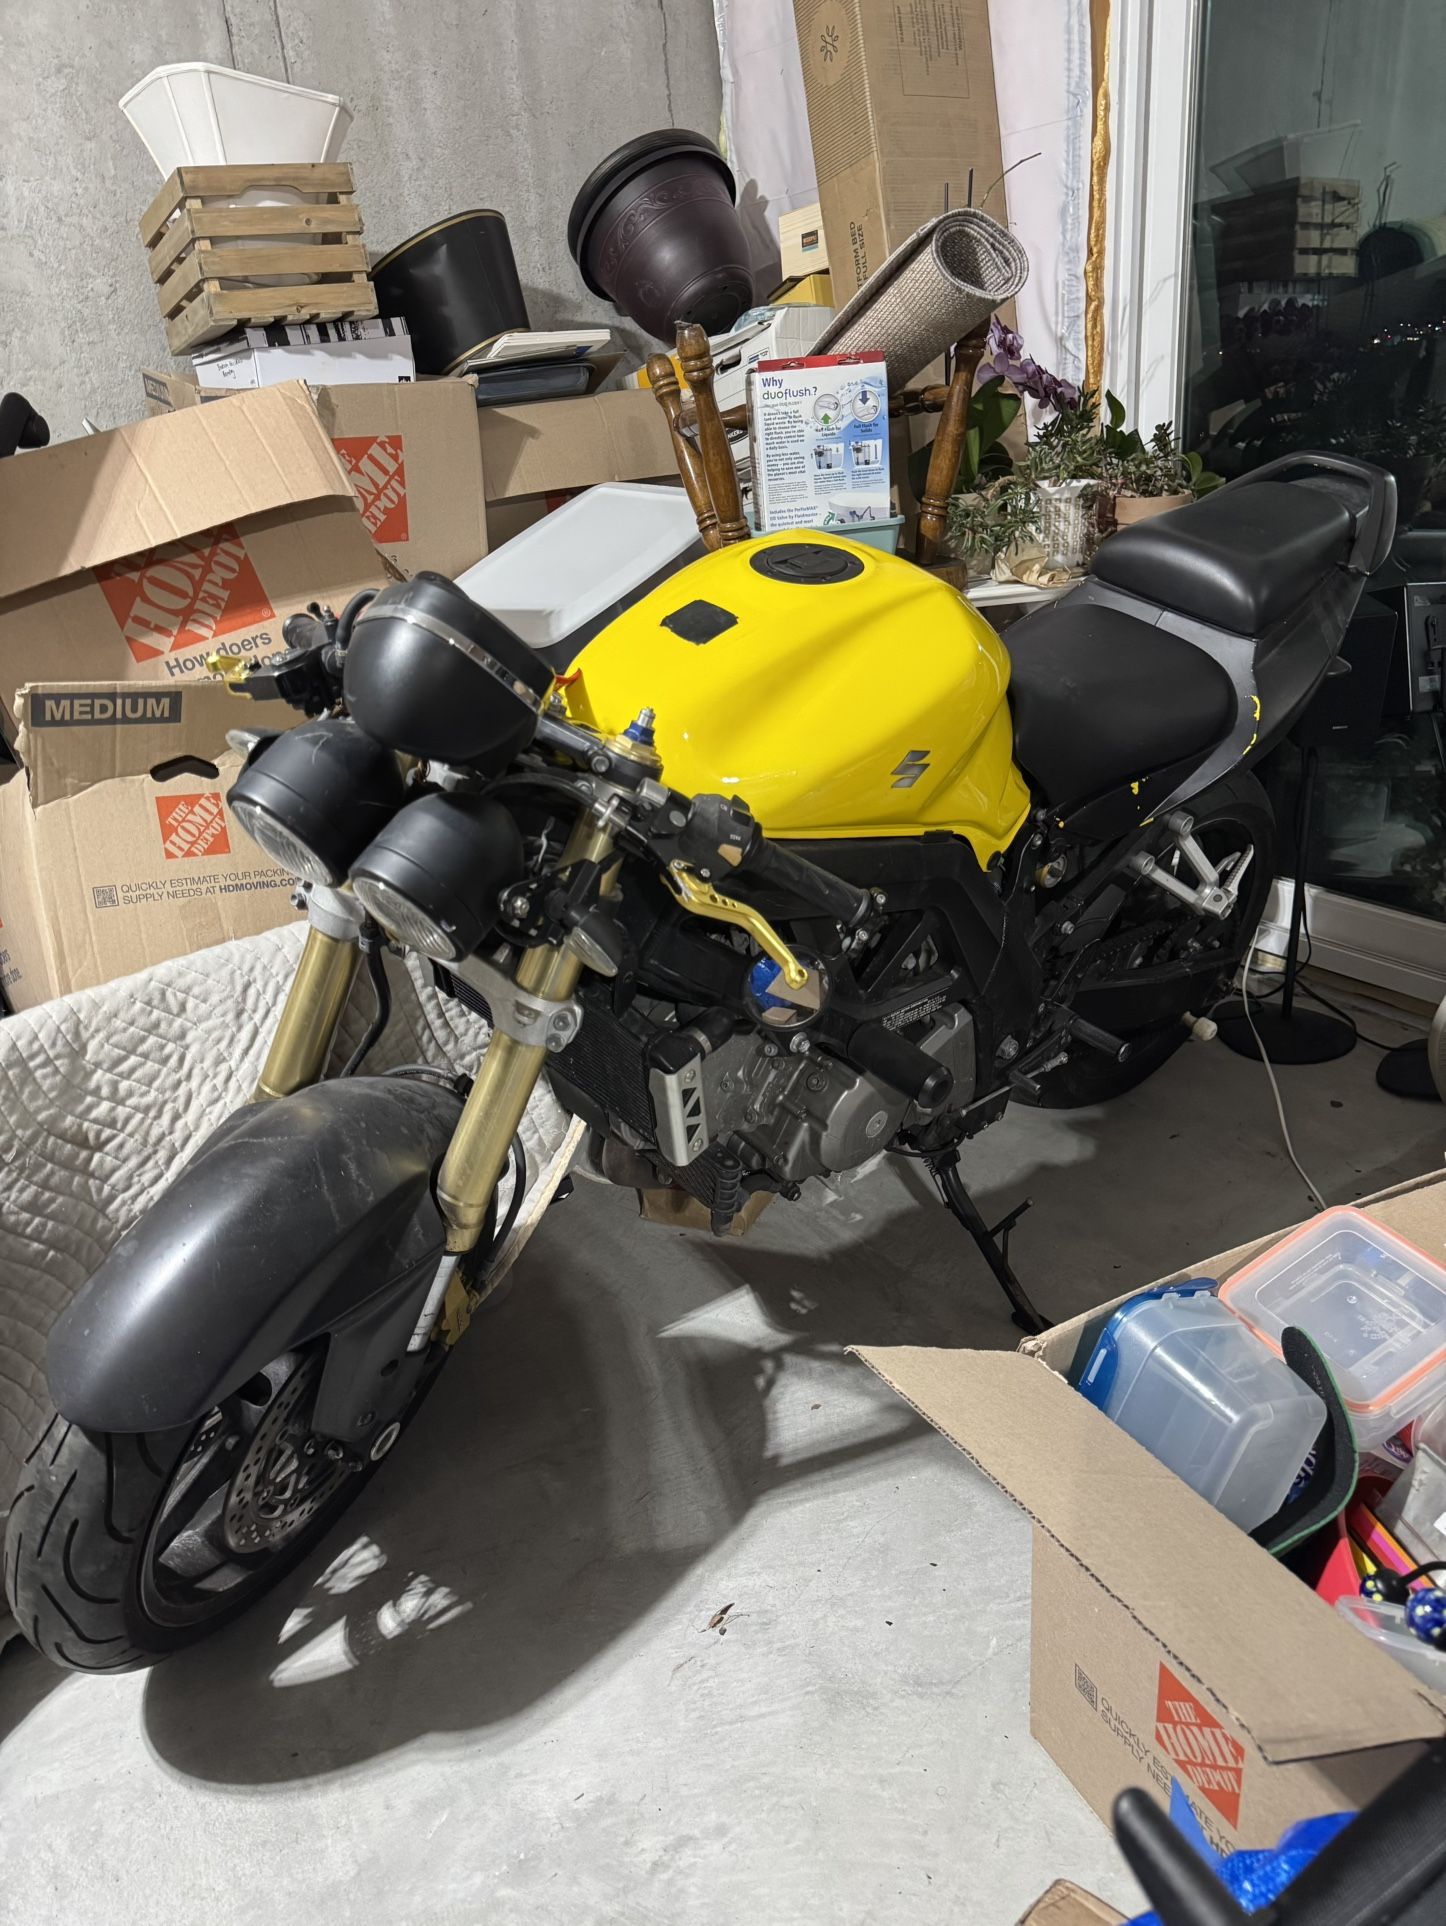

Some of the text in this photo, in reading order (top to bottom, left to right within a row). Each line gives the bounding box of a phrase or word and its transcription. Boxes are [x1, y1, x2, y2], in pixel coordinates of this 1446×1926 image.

[850, 221, 863, 291] TFORM BED
[857, 223, 869, 280] FULL SIZE
[761, 376, 784, 389] Why
[361, 474, 407, 534] EPOT
[121, 529, 219, 652] HOM
[184, 534, 247, 640] DEPOT
[164, 650, 211, 677] How
[215, 631, 273, 658] doers
[45, 697, 171, 721] MEDIUM
[163, 793, 222, 858] HOME
[165, 800, 191, 827] THE
[189, 815, 226, 857] DEPOT
[120, 868, 289, 893] QUICKLY ESTIMATE YOUR PACKIN
[123, 891, 164, 905] SUPPLY
[167, 888, 203, 900] NEEDS
[205, 885, 217, 896] AT
[1101, 1697, 1151, 1757] QUICKLY
[1164, 1699, 1201, 1722] THE
[1101, 1711, 1172, 1798] SUPPLY NEE
[1154, 1722, 1244, 1769] HOME
[1186, 1766, 1241, 1793] DEPOT
